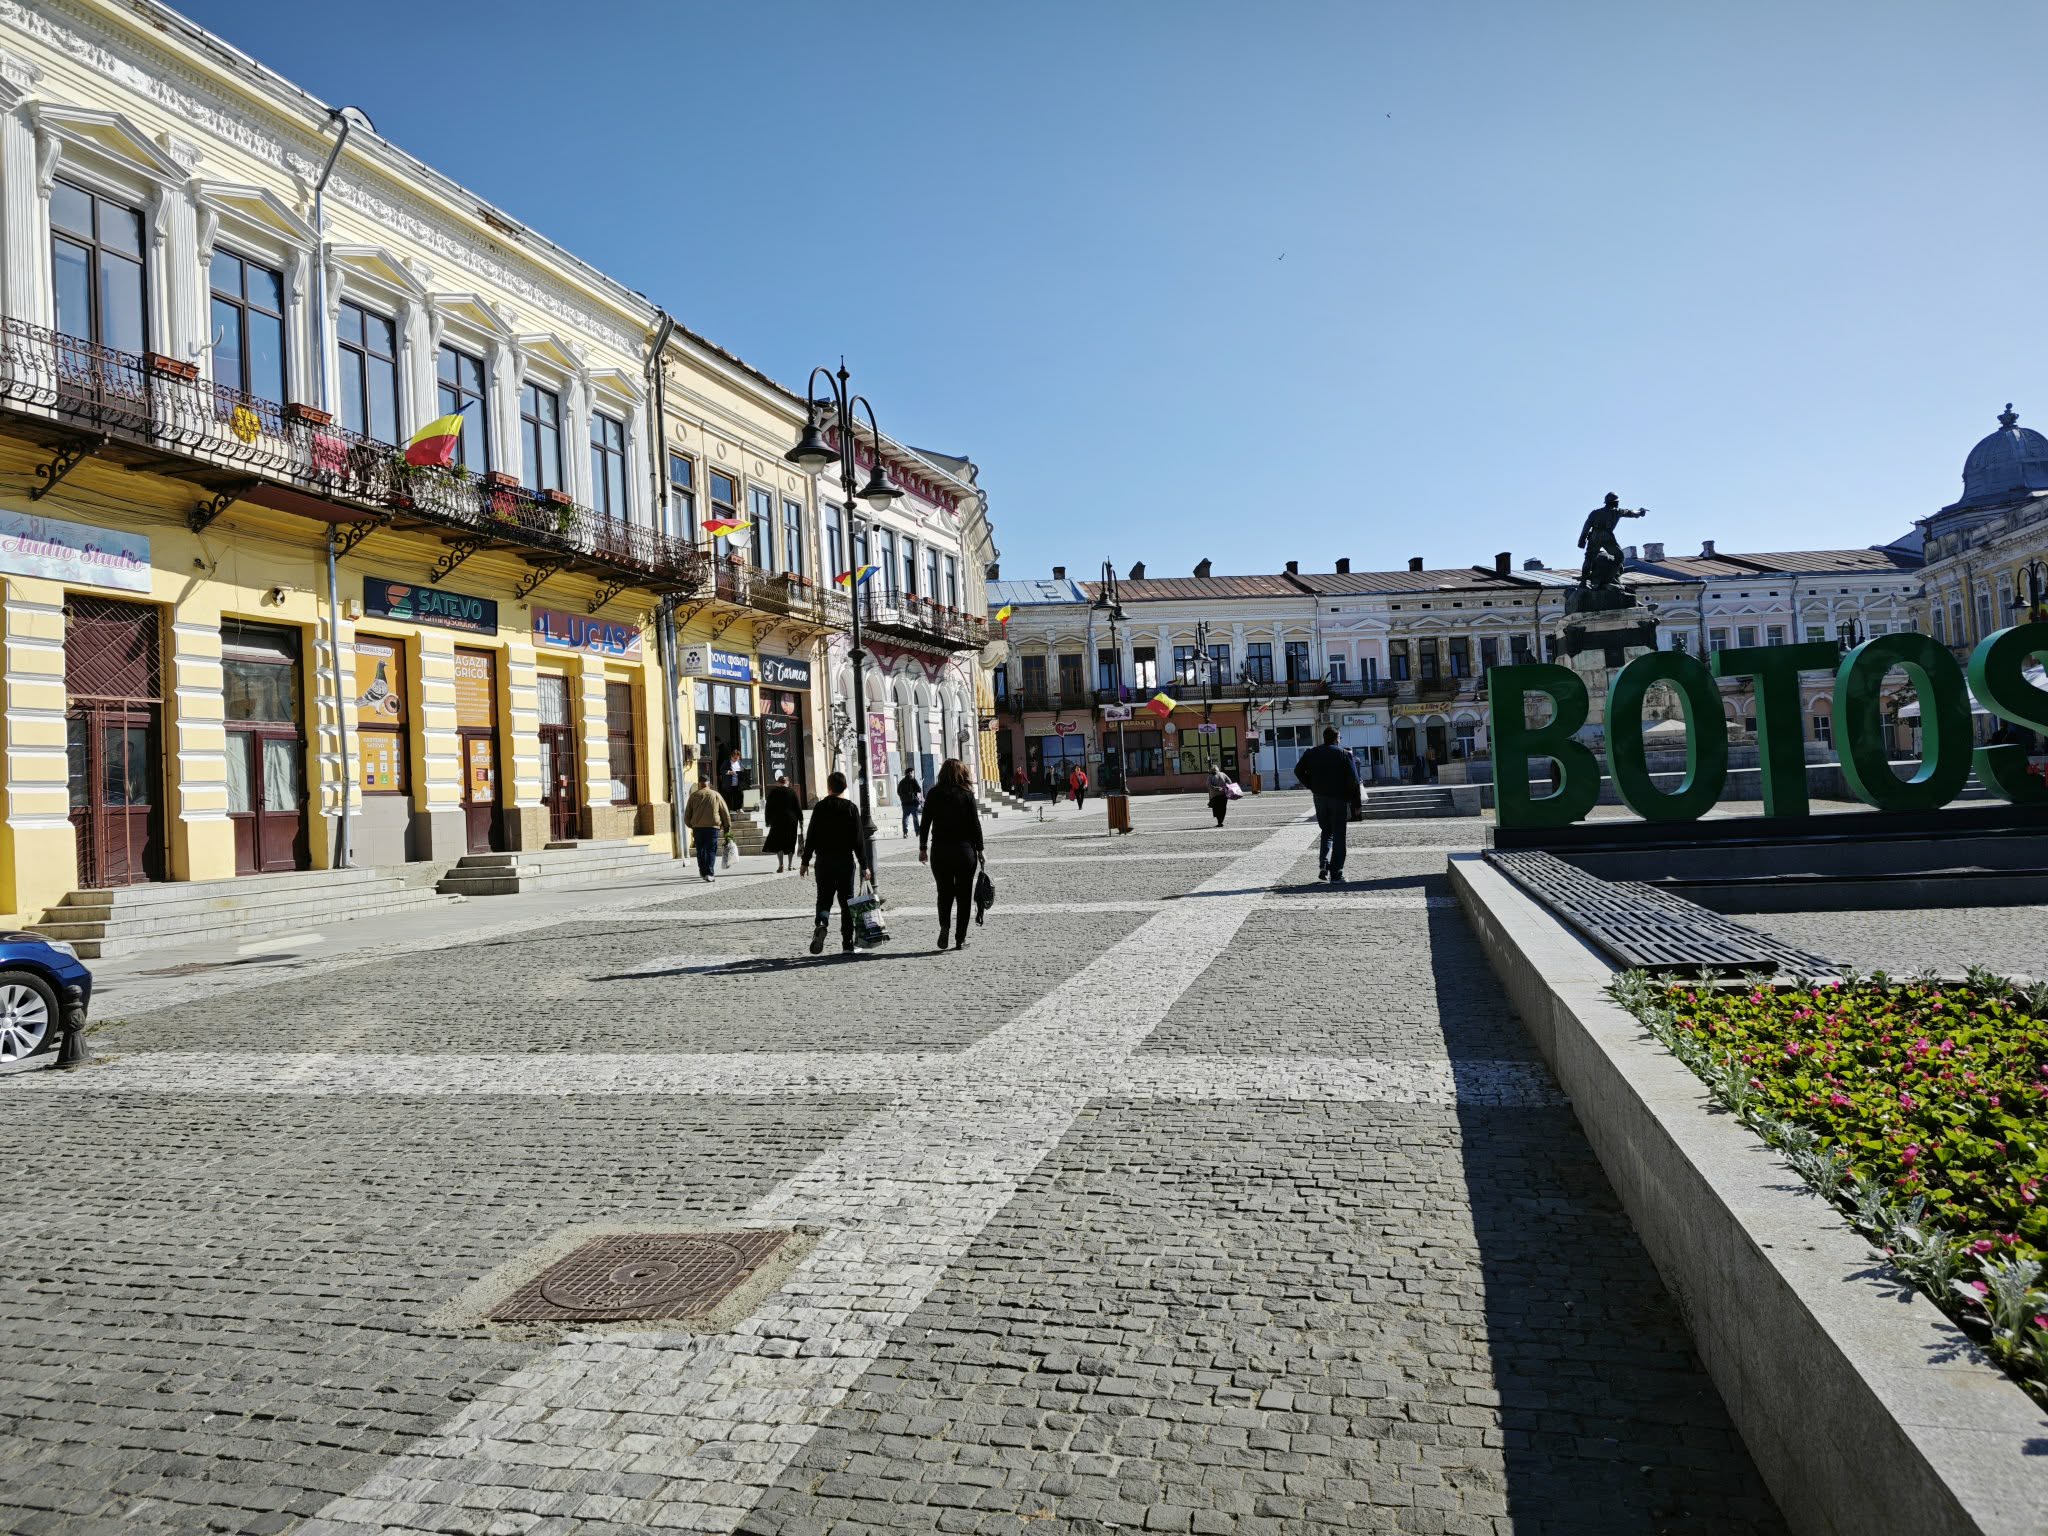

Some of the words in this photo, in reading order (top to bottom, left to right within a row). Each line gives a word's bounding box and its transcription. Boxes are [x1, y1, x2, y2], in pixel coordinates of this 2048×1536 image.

[2, 532, 76, 561] Audio
[80, 543, 146, 571] Studio
[418, 590, 482, 620] SATEVO
[543, 611, 628, 656] LUCAS
[455, 654, 489, 669] AGAZIN
[455, 666, 489, 680] GRICOL
[769, 660, 808, 682] Carmen
